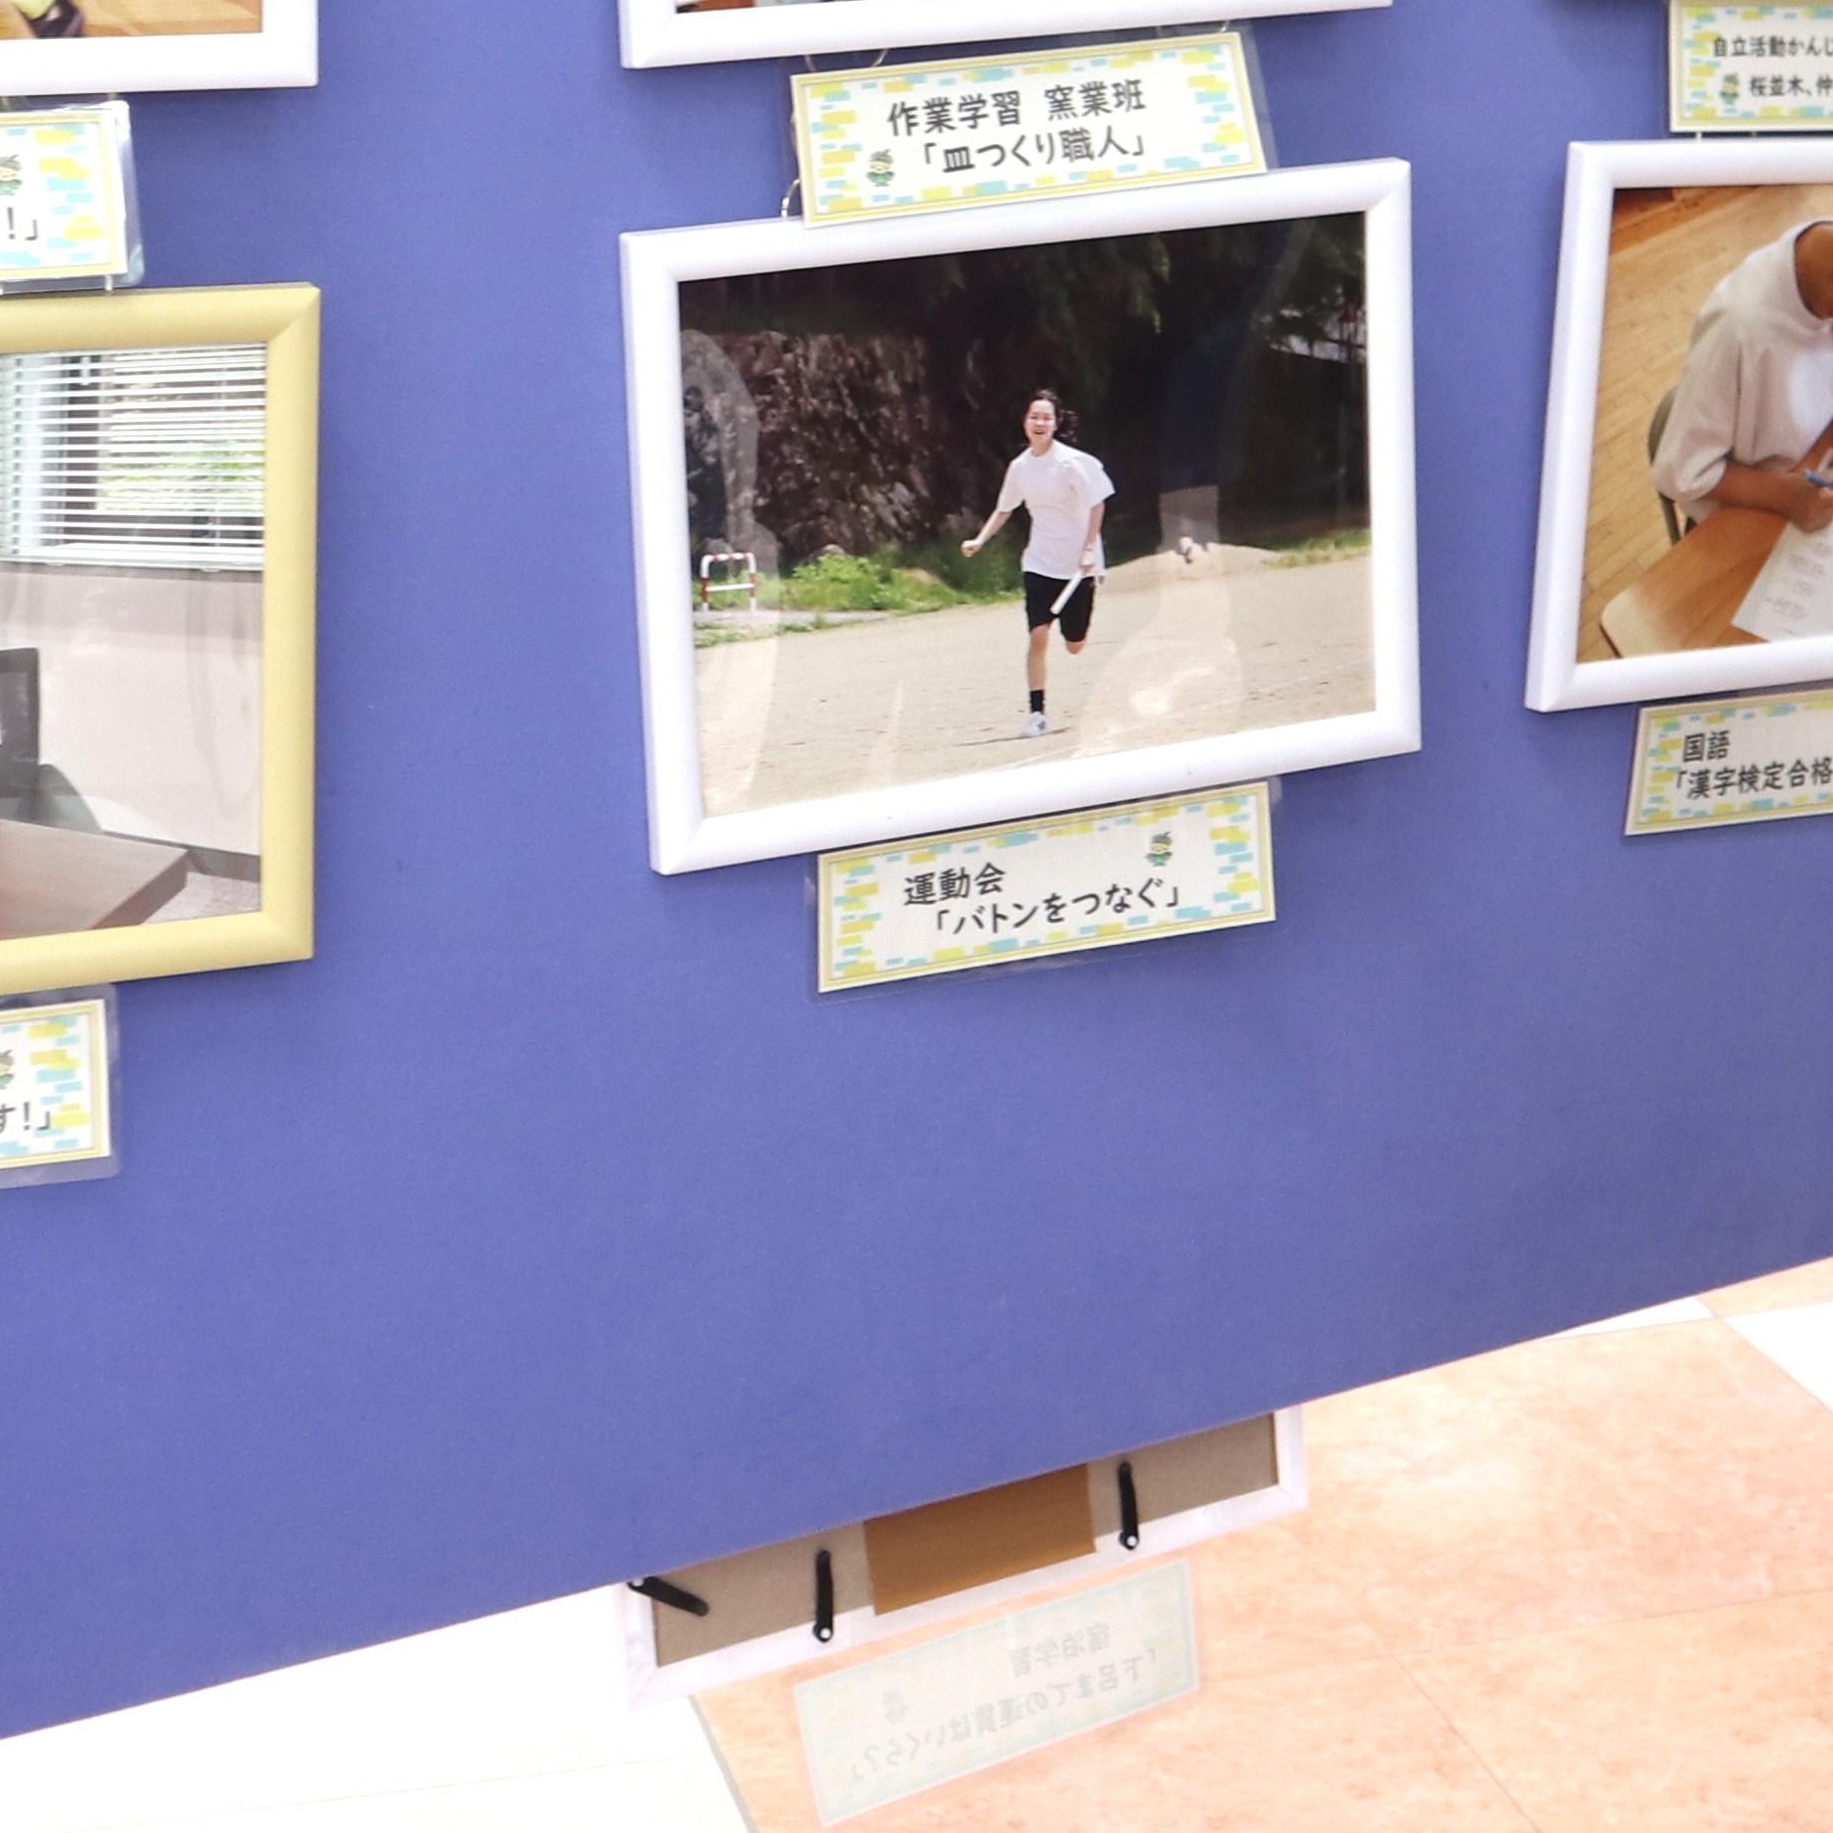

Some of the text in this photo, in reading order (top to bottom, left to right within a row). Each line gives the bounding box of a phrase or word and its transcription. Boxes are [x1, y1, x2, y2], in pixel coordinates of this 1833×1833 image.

[886, 78, 1147, 138] 作業学習 窯業班
[923, 123, 1146, 174] 「皿つくり職人」
[1682, 730, 1731, 764] 国語
[902, 861, 1007, 907] 運動会
[935, 877, 1179, 935] 「バトンをつなぐ」
